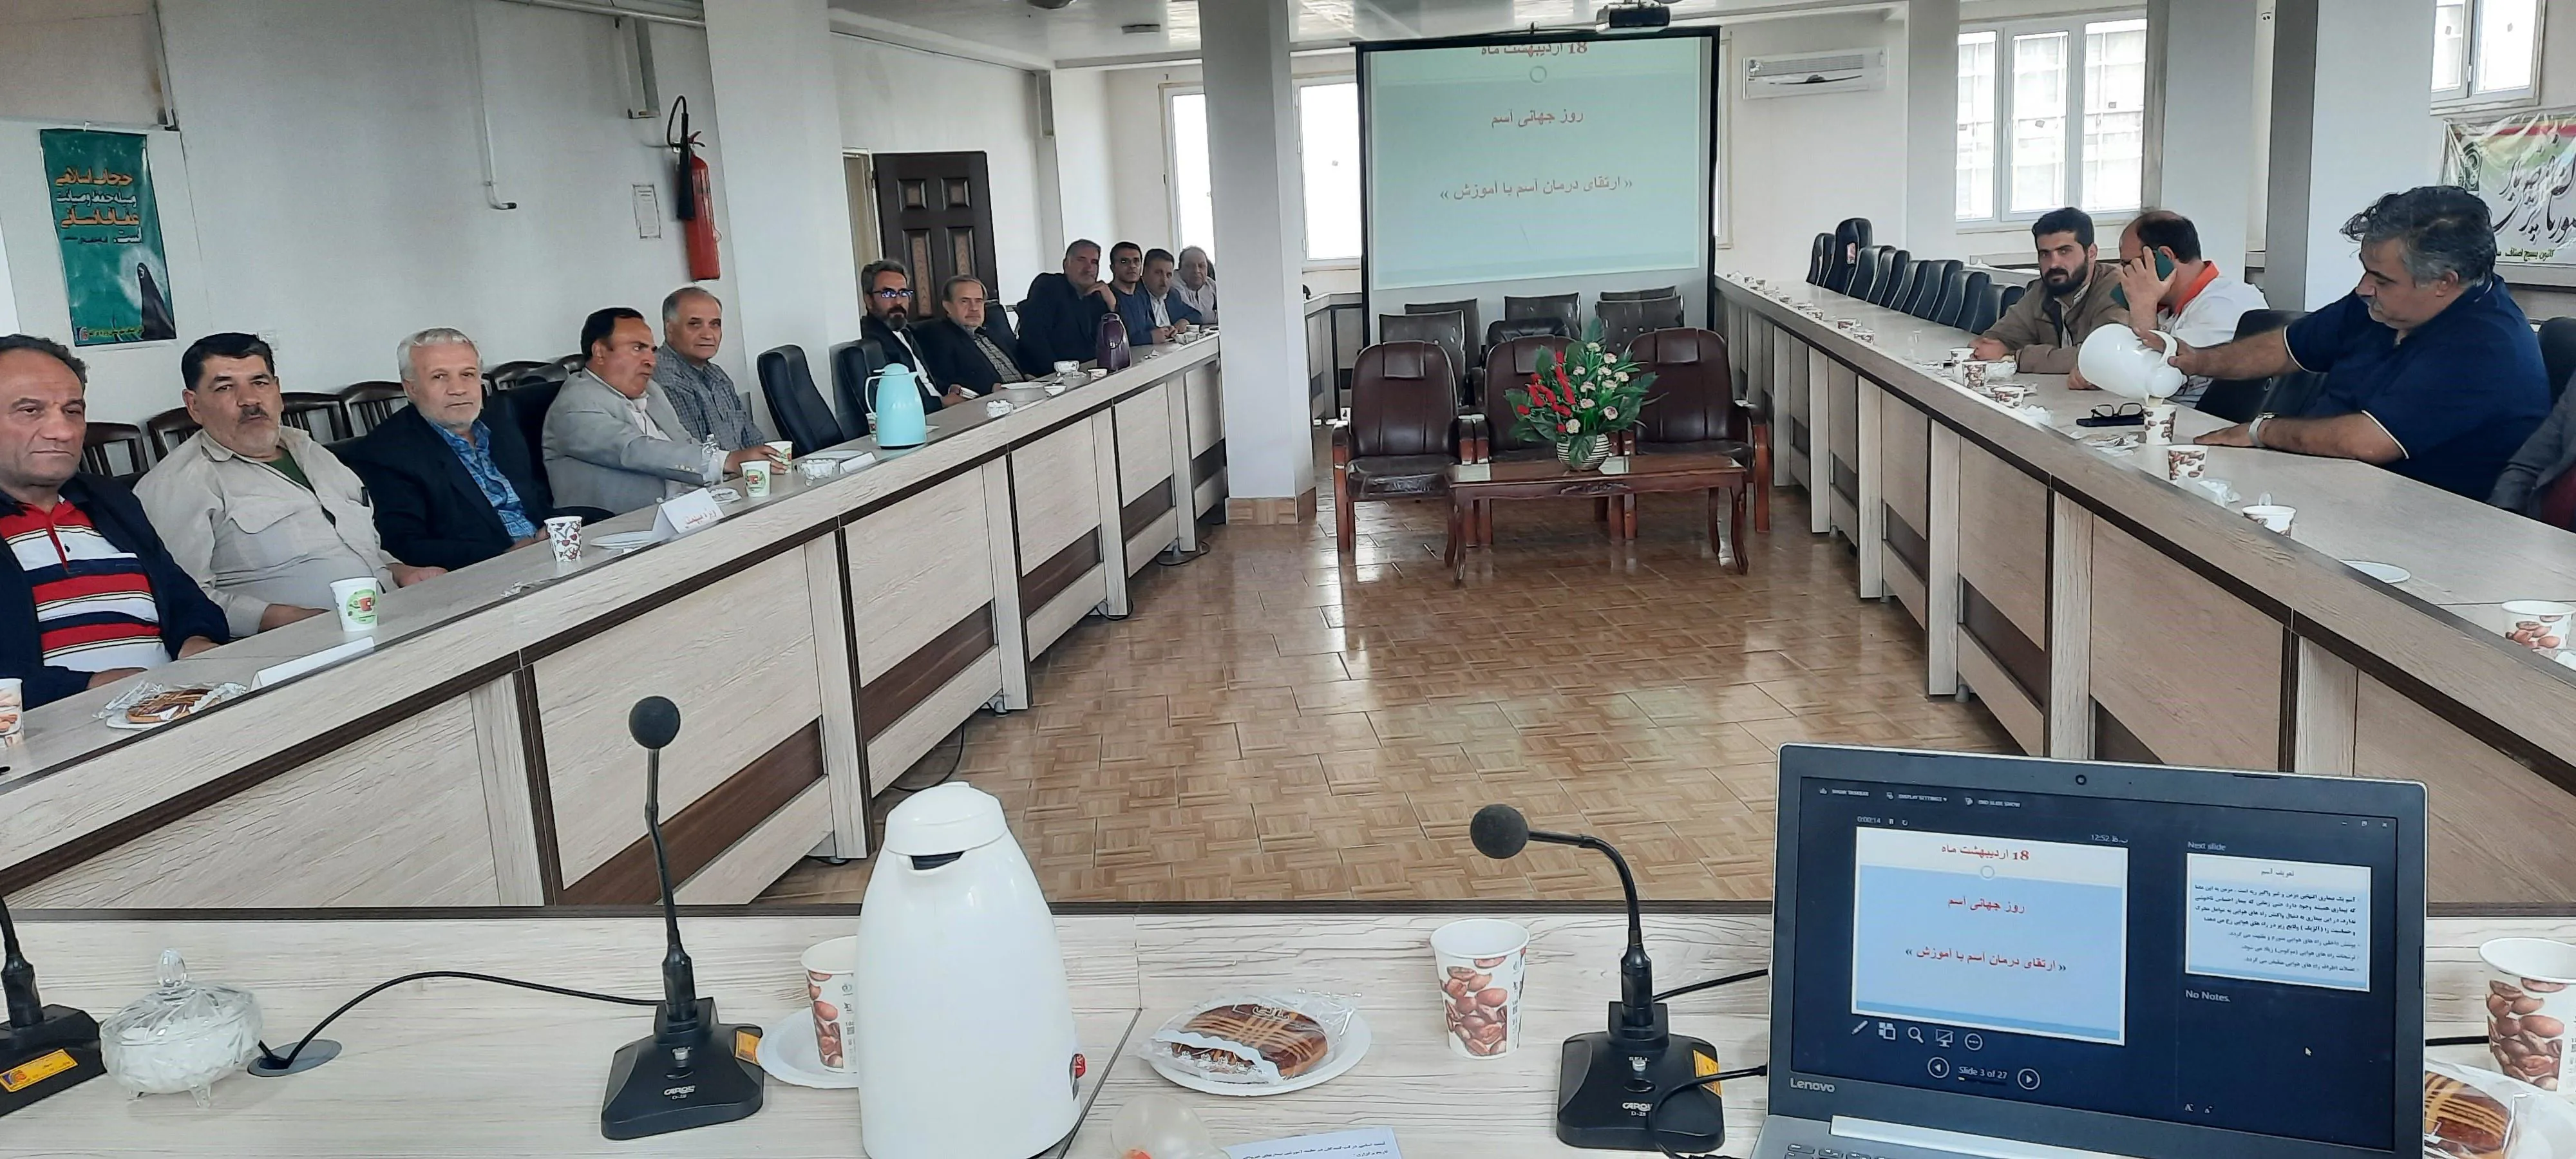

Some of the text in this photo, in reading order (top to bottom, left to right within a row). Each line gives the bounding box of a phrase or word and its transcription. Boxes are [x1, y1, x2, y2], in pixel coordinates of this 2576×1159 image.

[1482, 46, 1500, 55] ماه
[1518, 109, 1555, 127] جهانی
[1560, 108, 1584, 124] روز
[1454, 180, 1498, 200] آموزش
[1502, 182, 1513, 194] با
[1543, 178, 1578, 194] درمان
[1583, 175, 1620, 192] ارتقای
[1942, 844, 2030, 861] 18 اردیبهشت ماه
[2188, 841, 2226, 851] Next slide
[1969, 898, 2001, 912] جهانی
[2004, 900, 2025, 914] روز
[1916, 946, 1952, 960] آموزش
[1955, 950, 1965, 962] با
[1989, 954, 2020, 967] درمان
[2023, 957, 2056, 972] ارتقای
[2185, 989, 2200, 999] No
[1958, 1066, 2008, 1079] Slide 3 of 27
[1790, 1077, 1835, 1093] Lenovo
